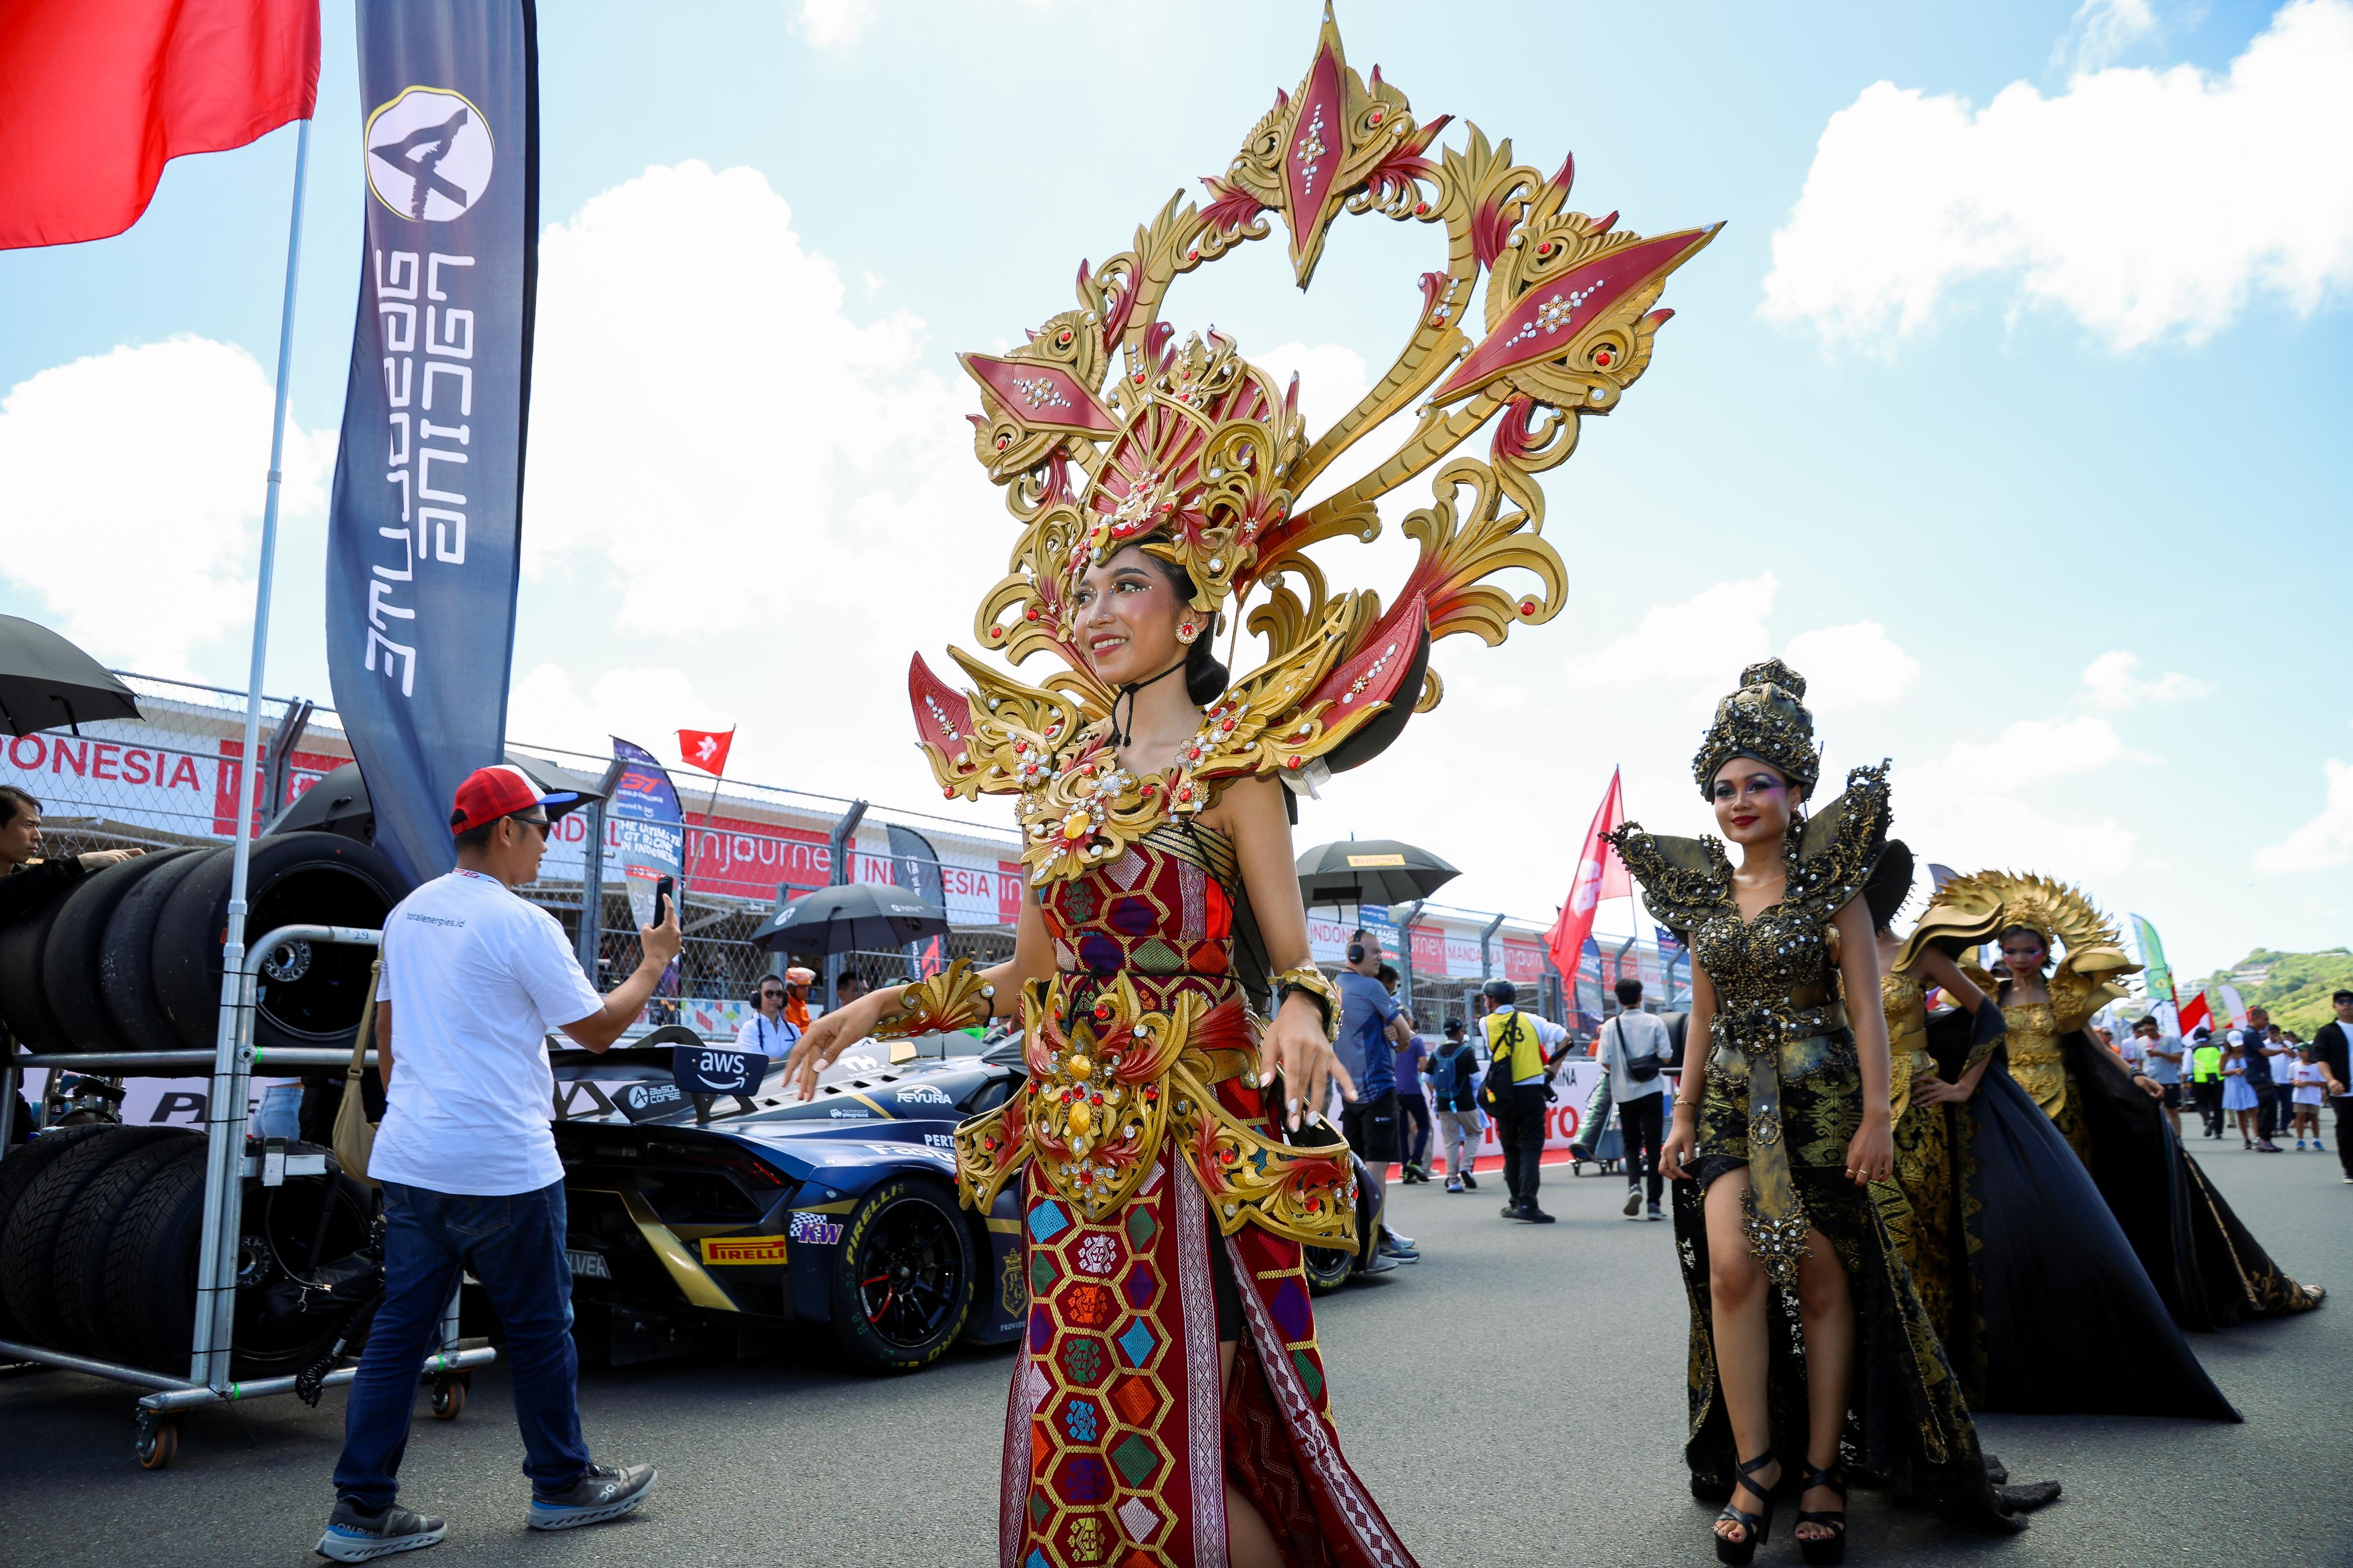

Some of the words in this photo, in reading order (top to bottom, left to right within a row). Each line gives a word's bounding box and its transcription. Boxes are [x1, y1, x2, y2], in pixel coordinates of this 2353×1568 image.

[0, 734, 201, 791] ONESIA
[354, 930, 368, 940] 29
[700, 1052, 745, 1074] aws
[897, 1092, 953, 1104] REVURA
[798, 1223, 844, 1245] KW
[846, 1186, 897, 1265] PIRELLI
[708, 1241, 786, 1260] PIRELLI
